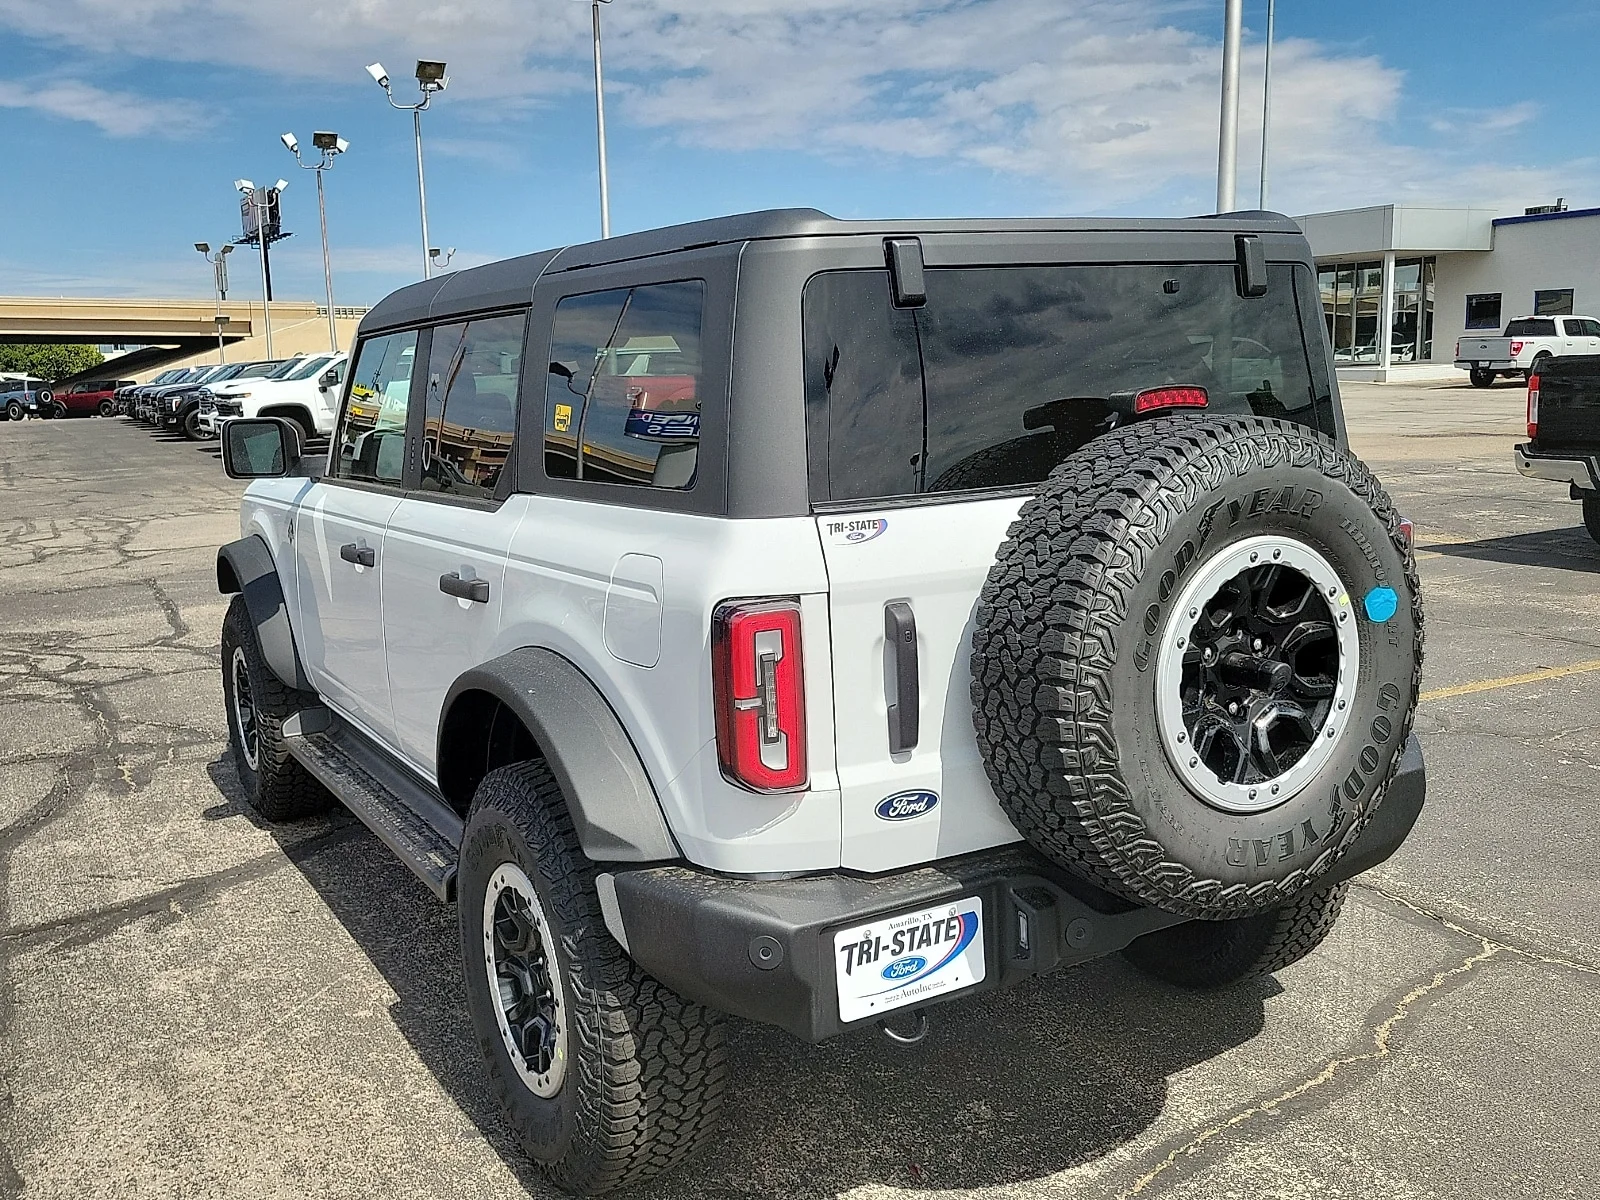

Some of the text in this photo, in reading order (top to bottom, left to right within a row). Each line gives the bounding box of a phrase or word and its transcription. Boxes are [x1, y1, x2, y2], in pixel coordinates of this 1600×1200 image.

[826, 519, 879, 536] TRI-STATE
[888, 794, 929, 817] Ford
[888, 912, 933, 930] Amarillo, TX
[840, 915, 959, 976] TRI-STATE
[890, 959, 918, 978] Ford
